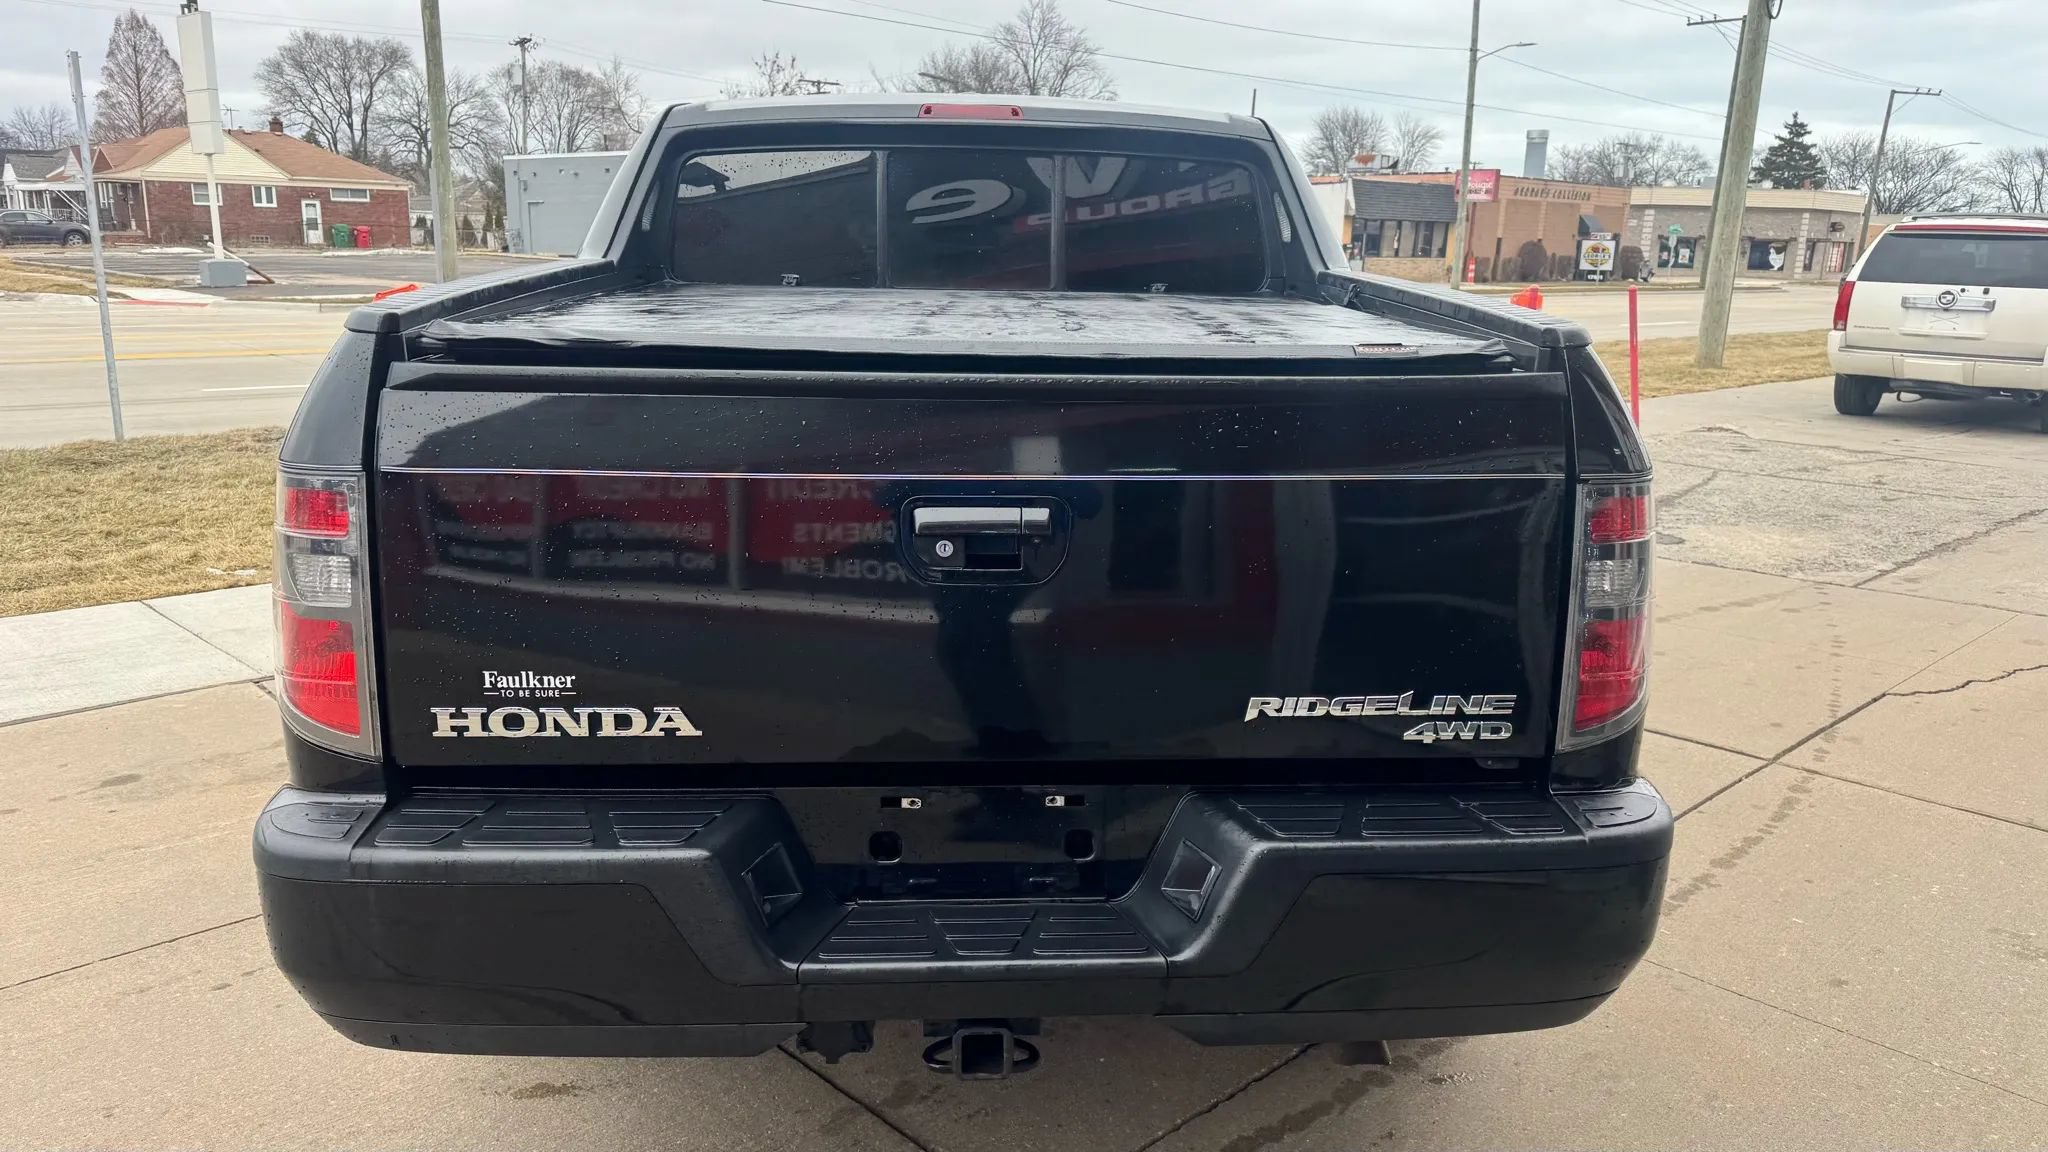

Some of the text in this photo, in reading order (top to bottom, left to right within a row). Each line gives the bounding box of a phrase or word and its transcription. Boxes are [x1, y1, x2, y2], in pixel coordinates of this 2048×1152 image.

[1552, 188, 1591, 201] COLLISION
[482, 670, 576, 689] Faulkner
[500, 689, 560, 698] TO BE SURE
[1244, 689, 1518, 722] RIDGELINE
[430, 706, 703, 738] HONDA
[1402, 721, 1514, 744] 4WD
